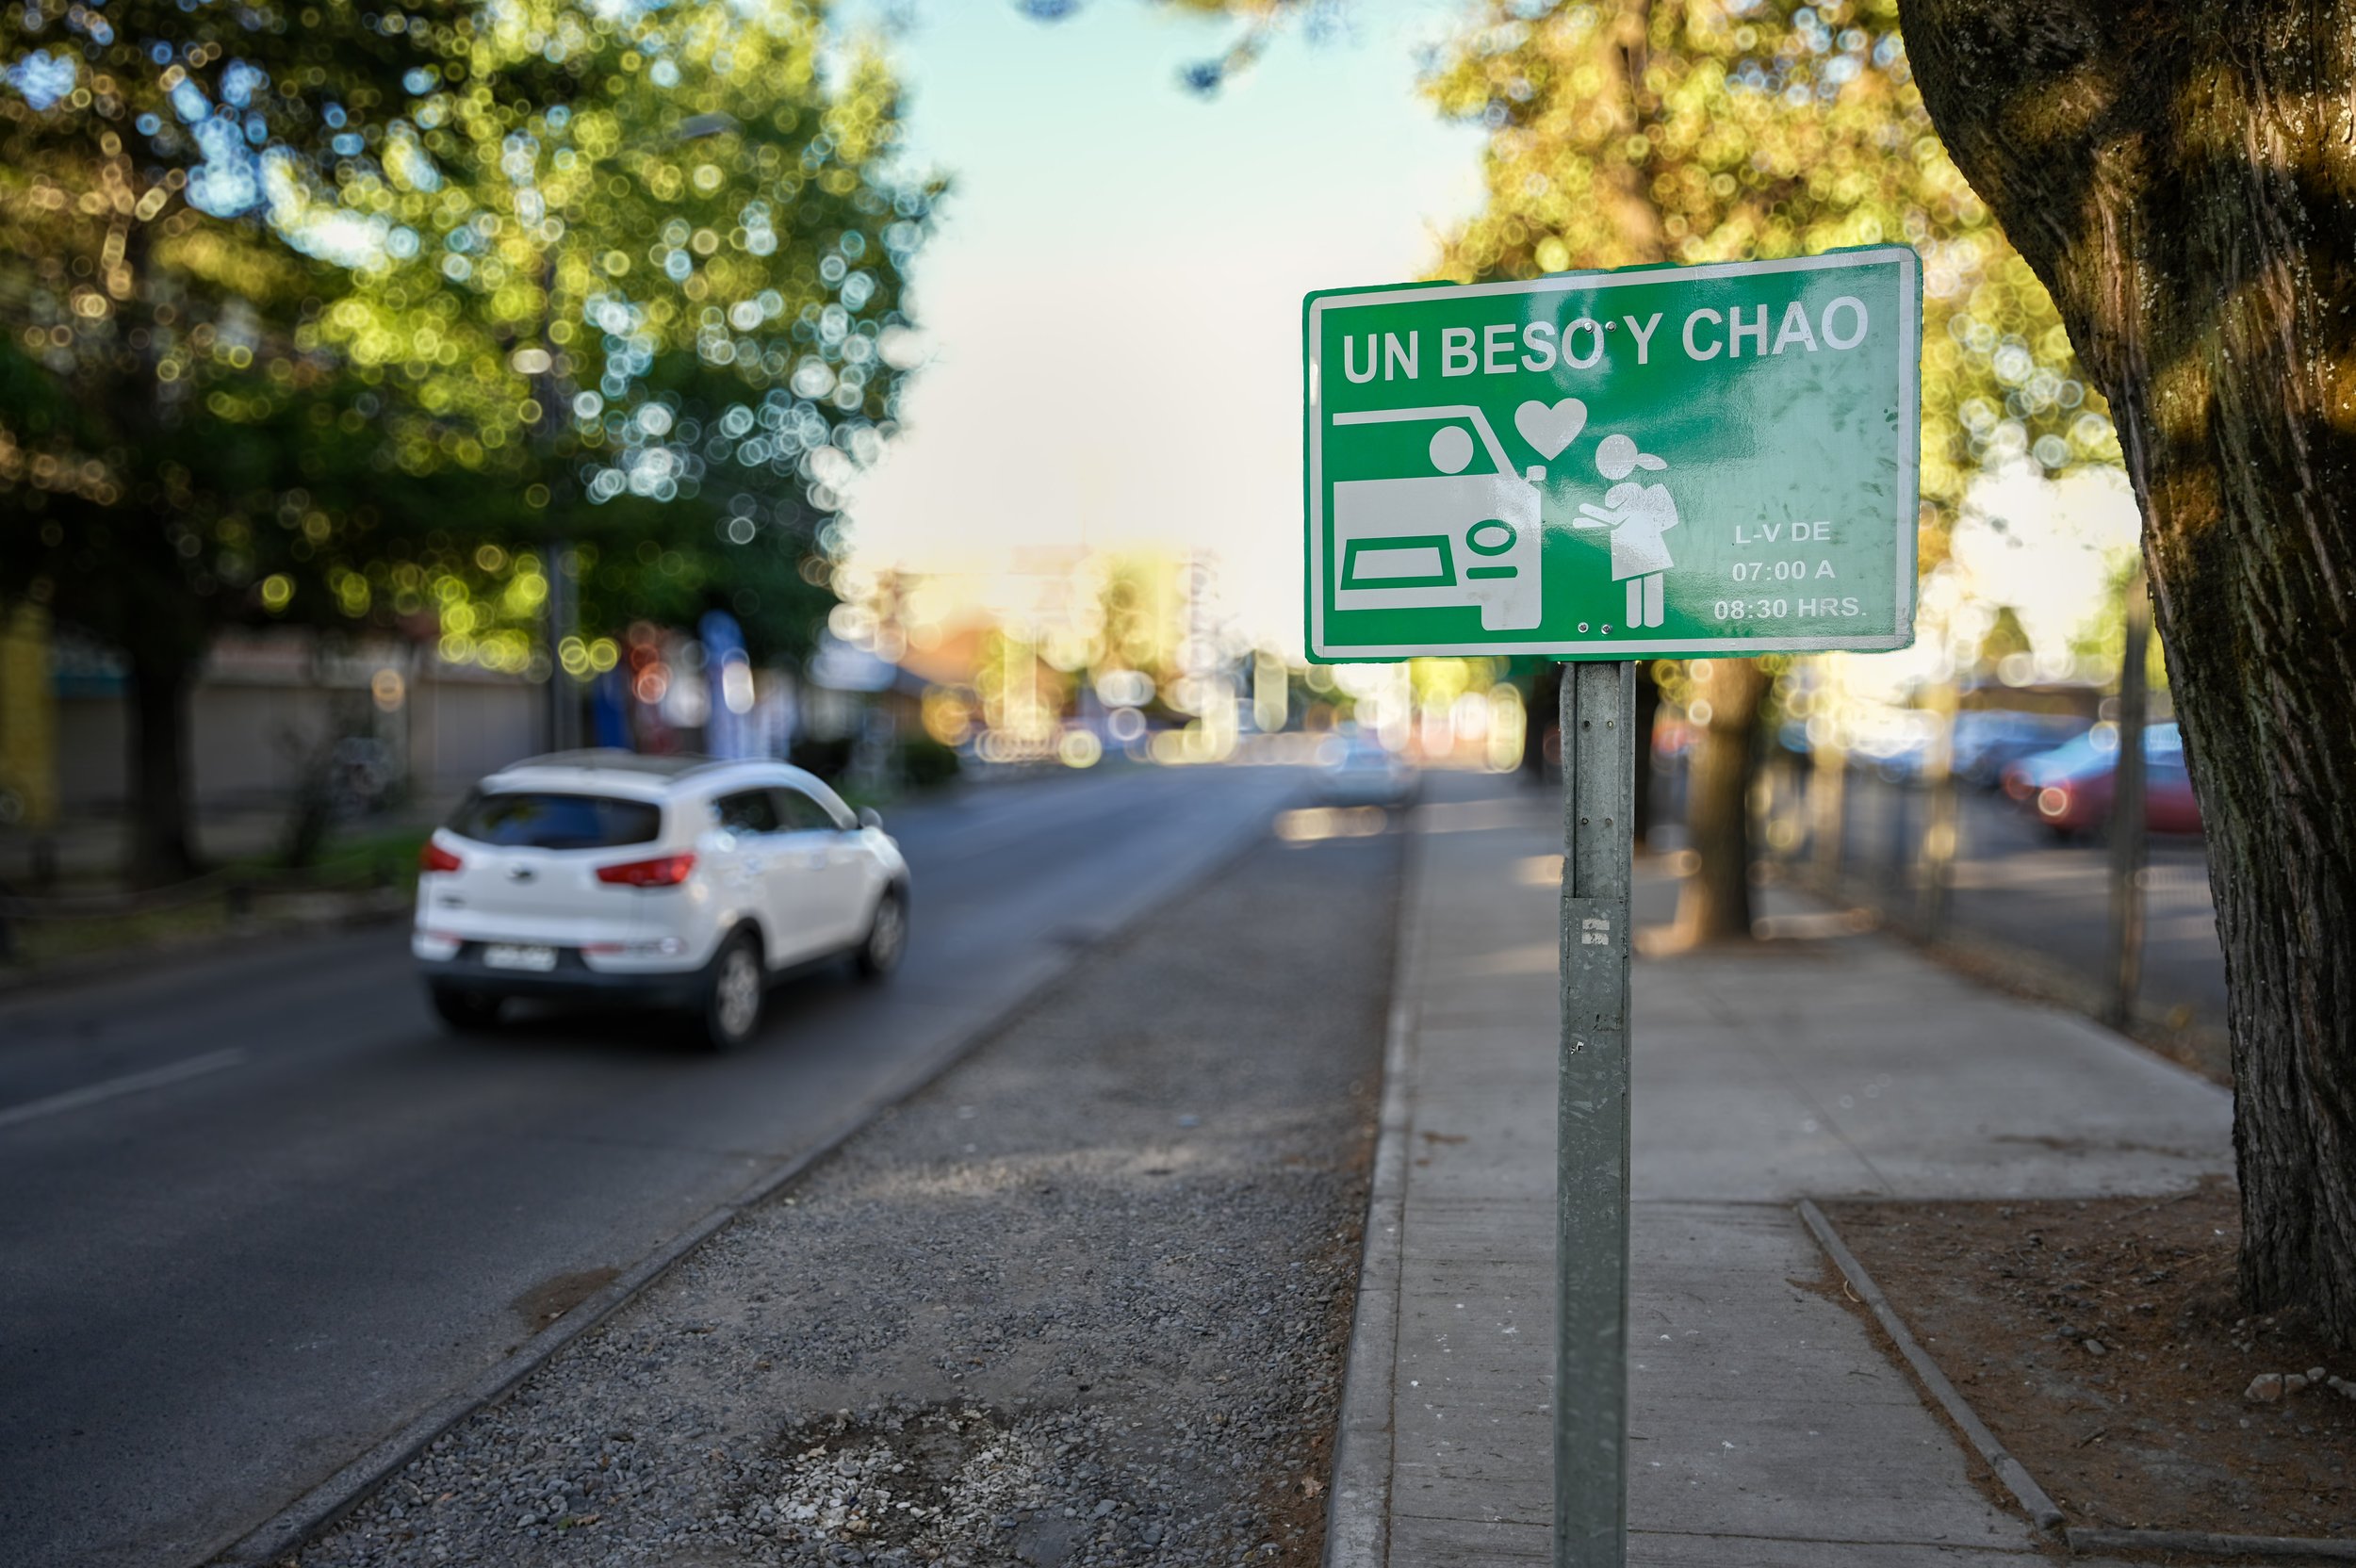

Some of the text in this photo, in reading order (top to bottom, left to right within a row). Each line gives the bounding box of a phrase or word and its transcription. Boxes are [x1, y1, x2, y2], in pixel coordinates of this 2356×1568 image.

[1344, 296, 1869, 384] UN BESO Y CHAO
[1735, 521, 1831, 544] L-V DE
[1732, 559, 1836, 581] 07:00 A
[1714, 597, 1867, 620] 08:30 HRS.
